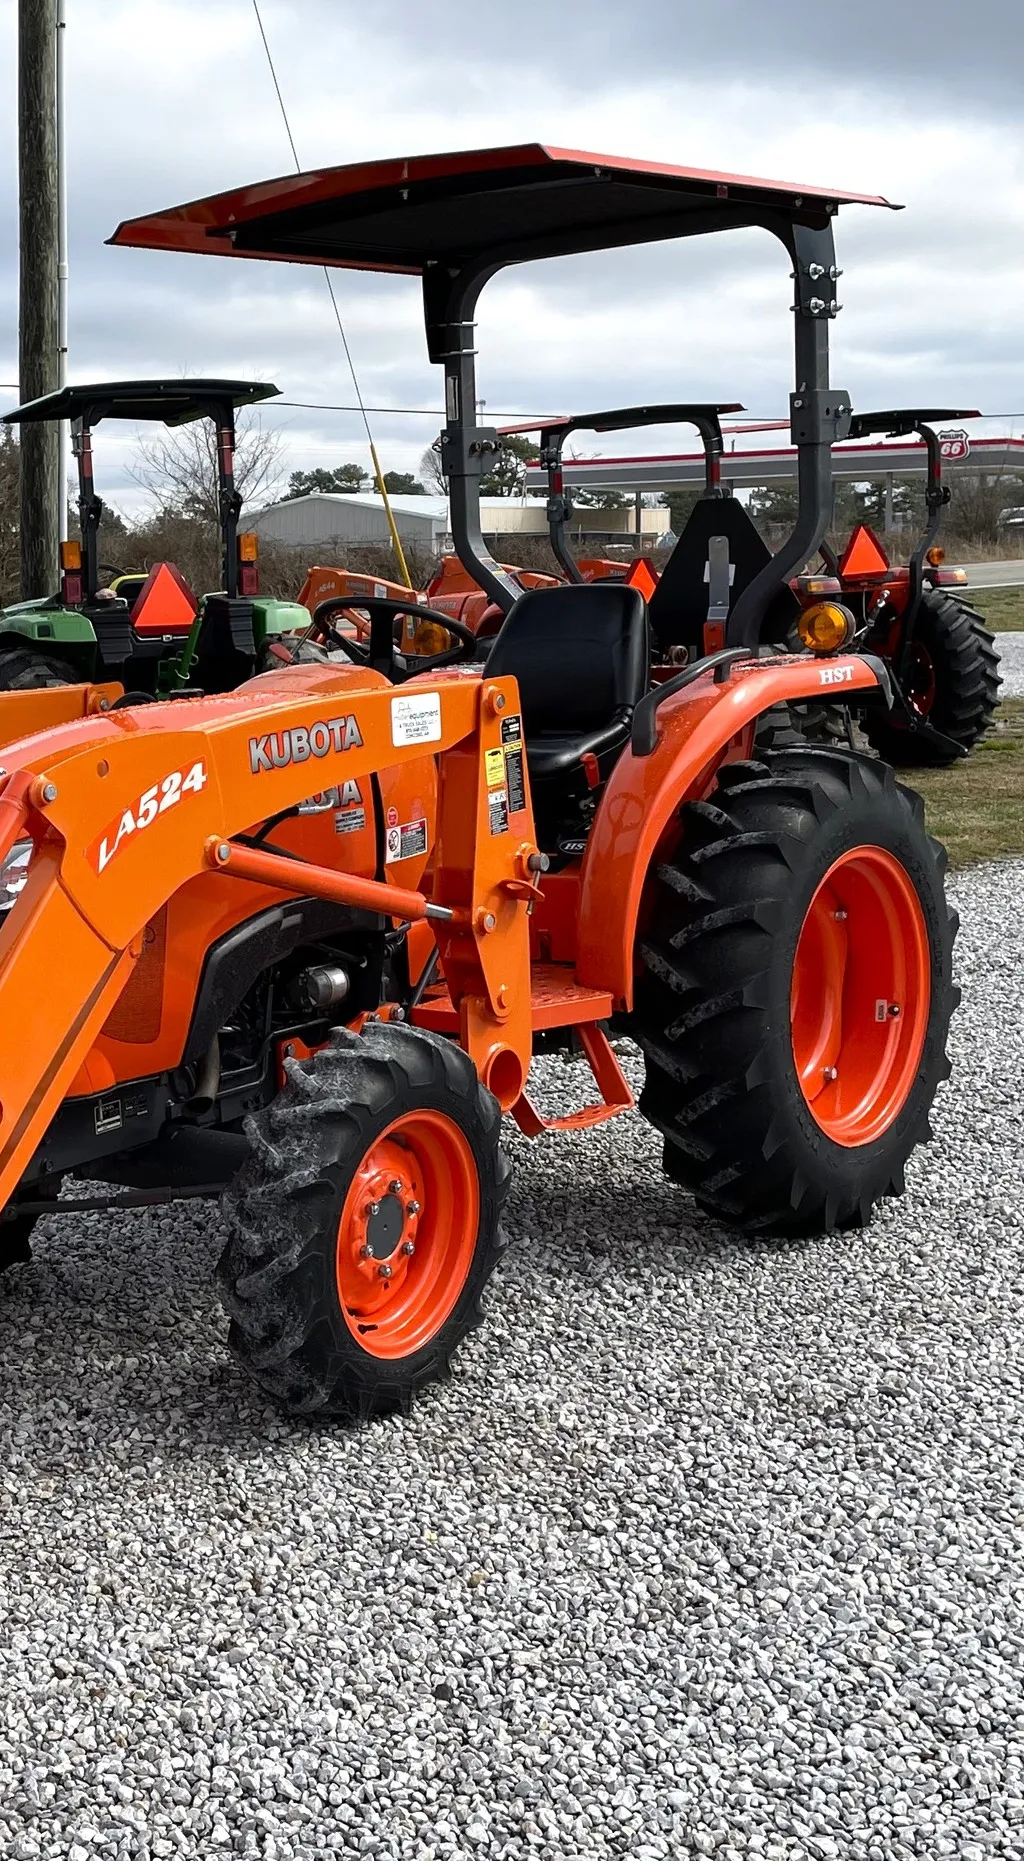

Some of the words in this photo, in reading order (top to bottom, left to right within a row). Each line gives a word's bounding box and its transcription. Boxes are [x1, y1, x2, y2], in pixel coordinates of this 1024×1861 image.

[940, 442, 963, 455] 66
[818, 665, 855, 686] HST
[249, 714, 364, 775] KUBOTA
[97, 762, 208, 874] LA524
[563, 842, 587, 850] HS
